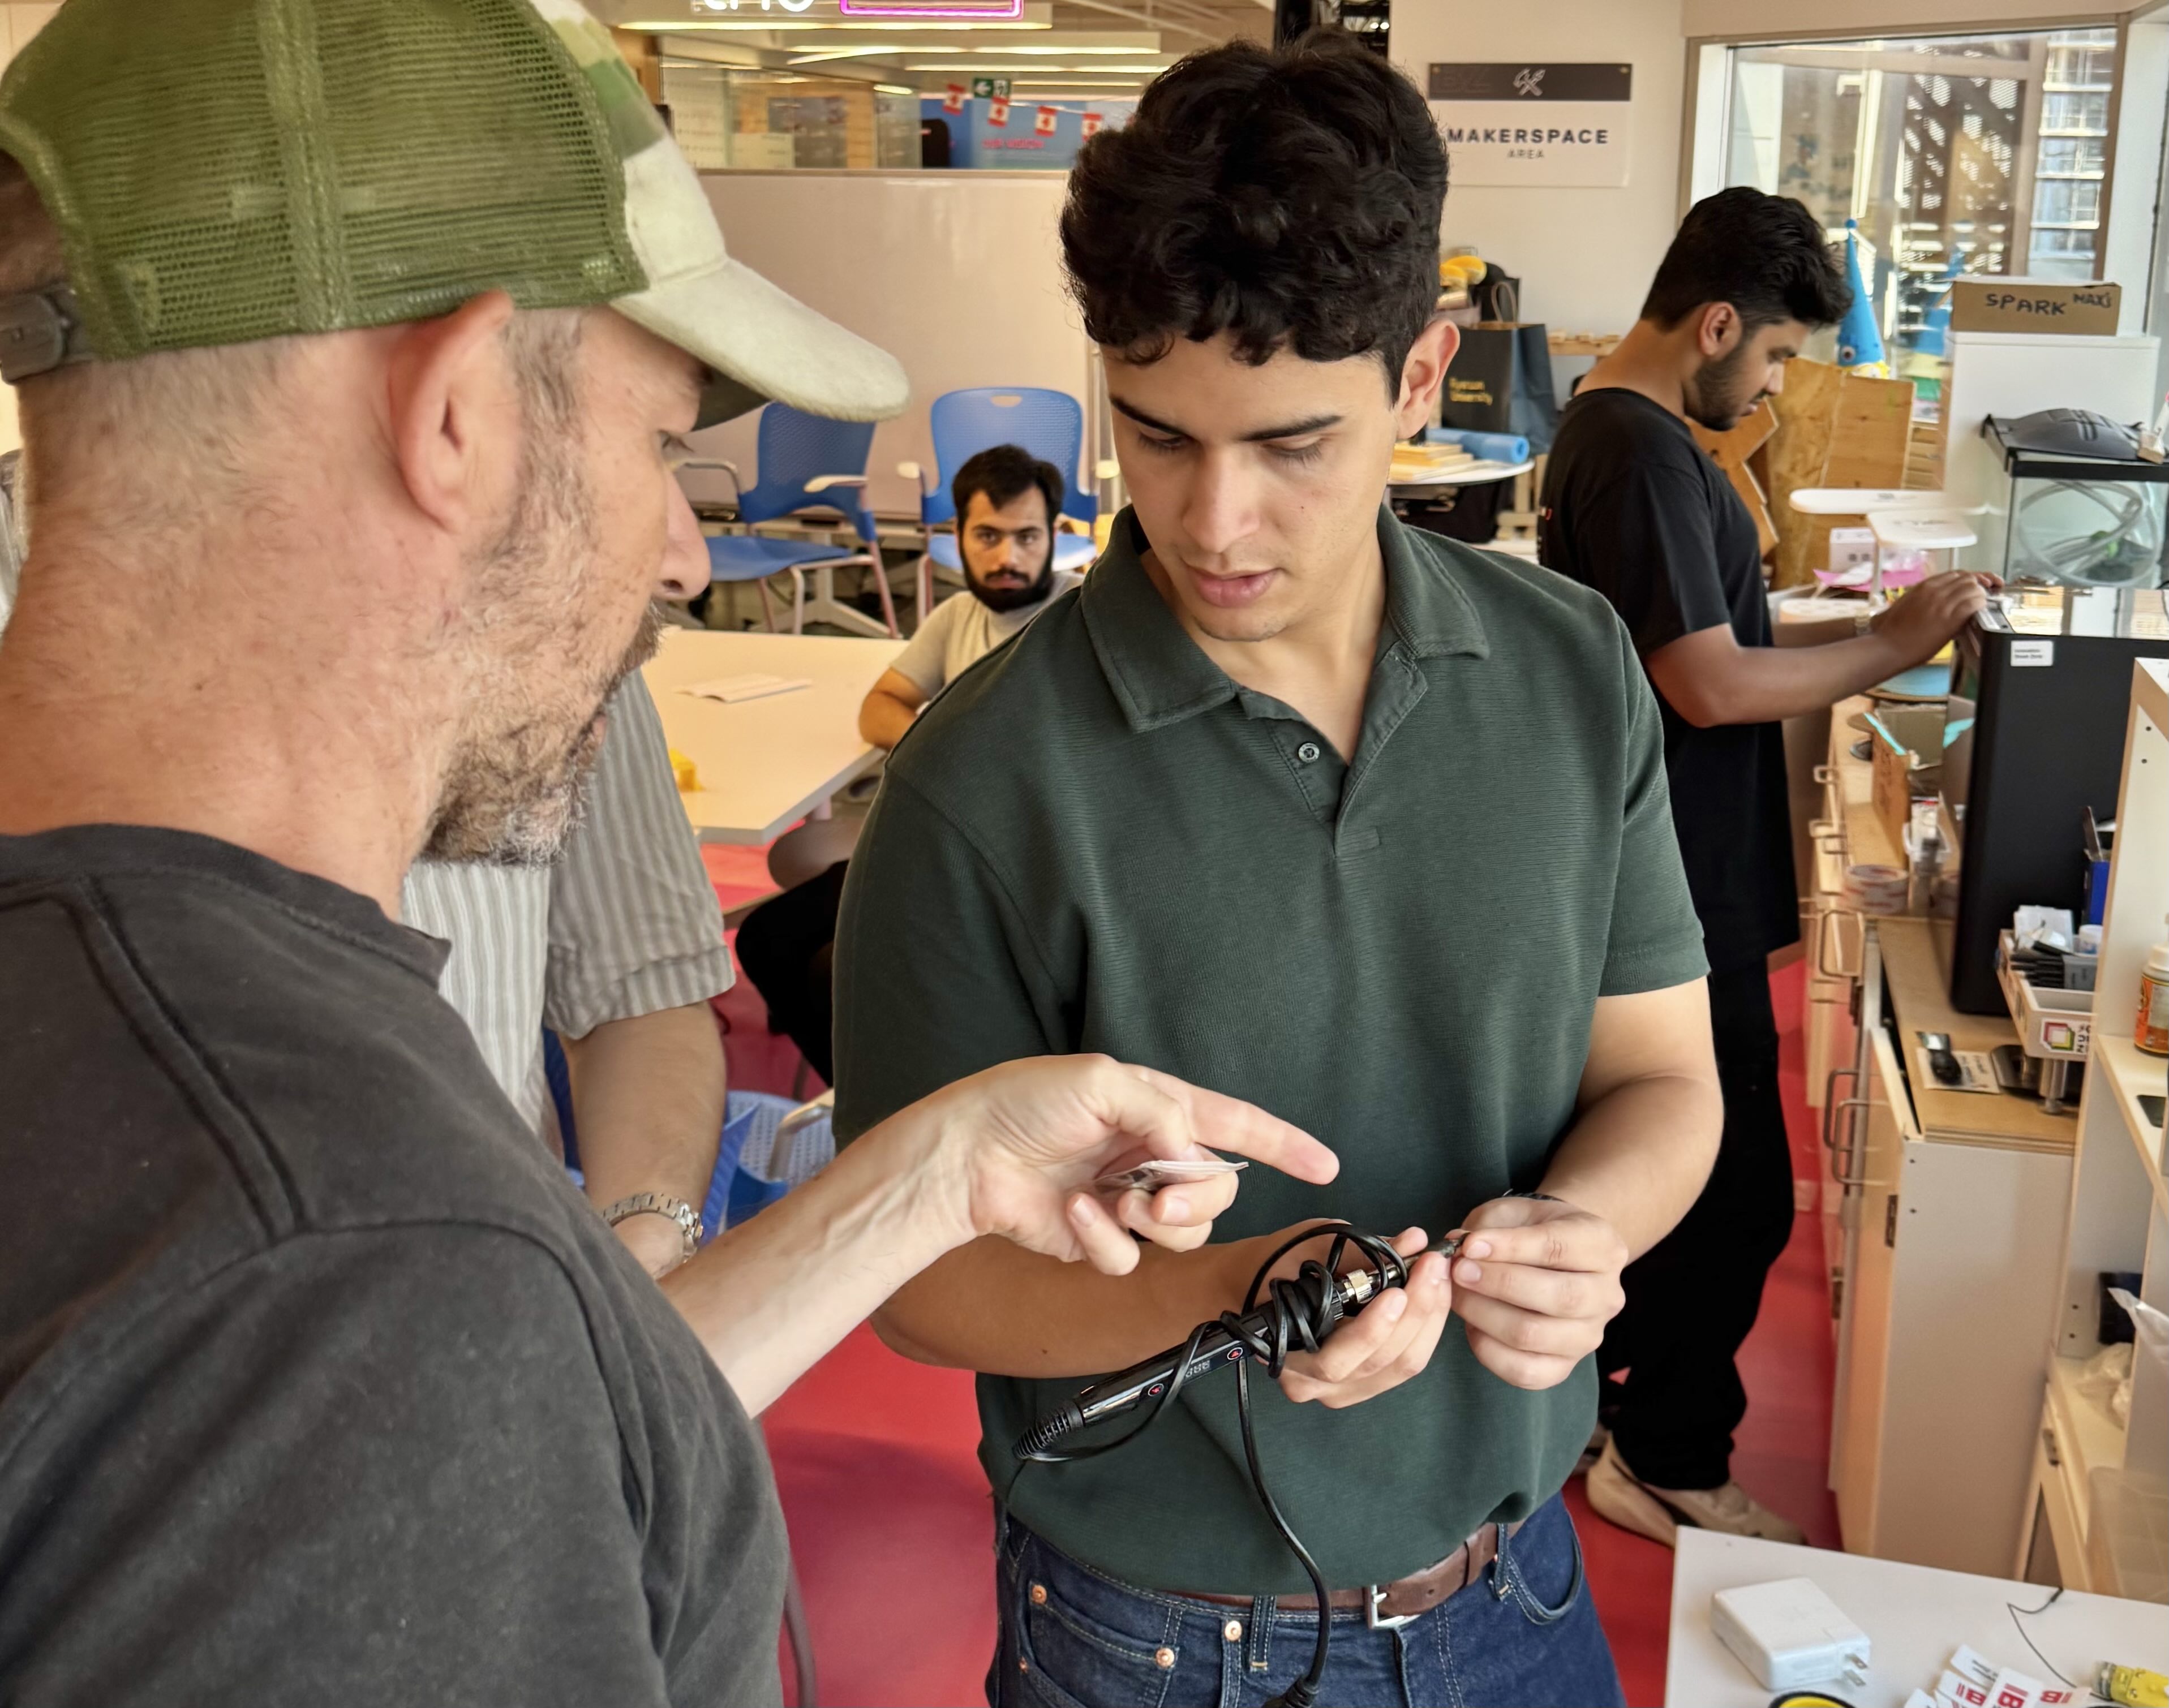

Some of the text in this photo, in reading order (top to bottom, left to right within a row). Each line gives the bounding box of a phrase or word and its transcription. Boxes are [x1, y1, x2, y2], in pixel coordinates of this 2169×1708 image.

[1447, 128, 1609, 144] MAKERSPACE
[1507, 149, 1544, 159] AREA
[1986, 294, 2067, 315] SPARK
